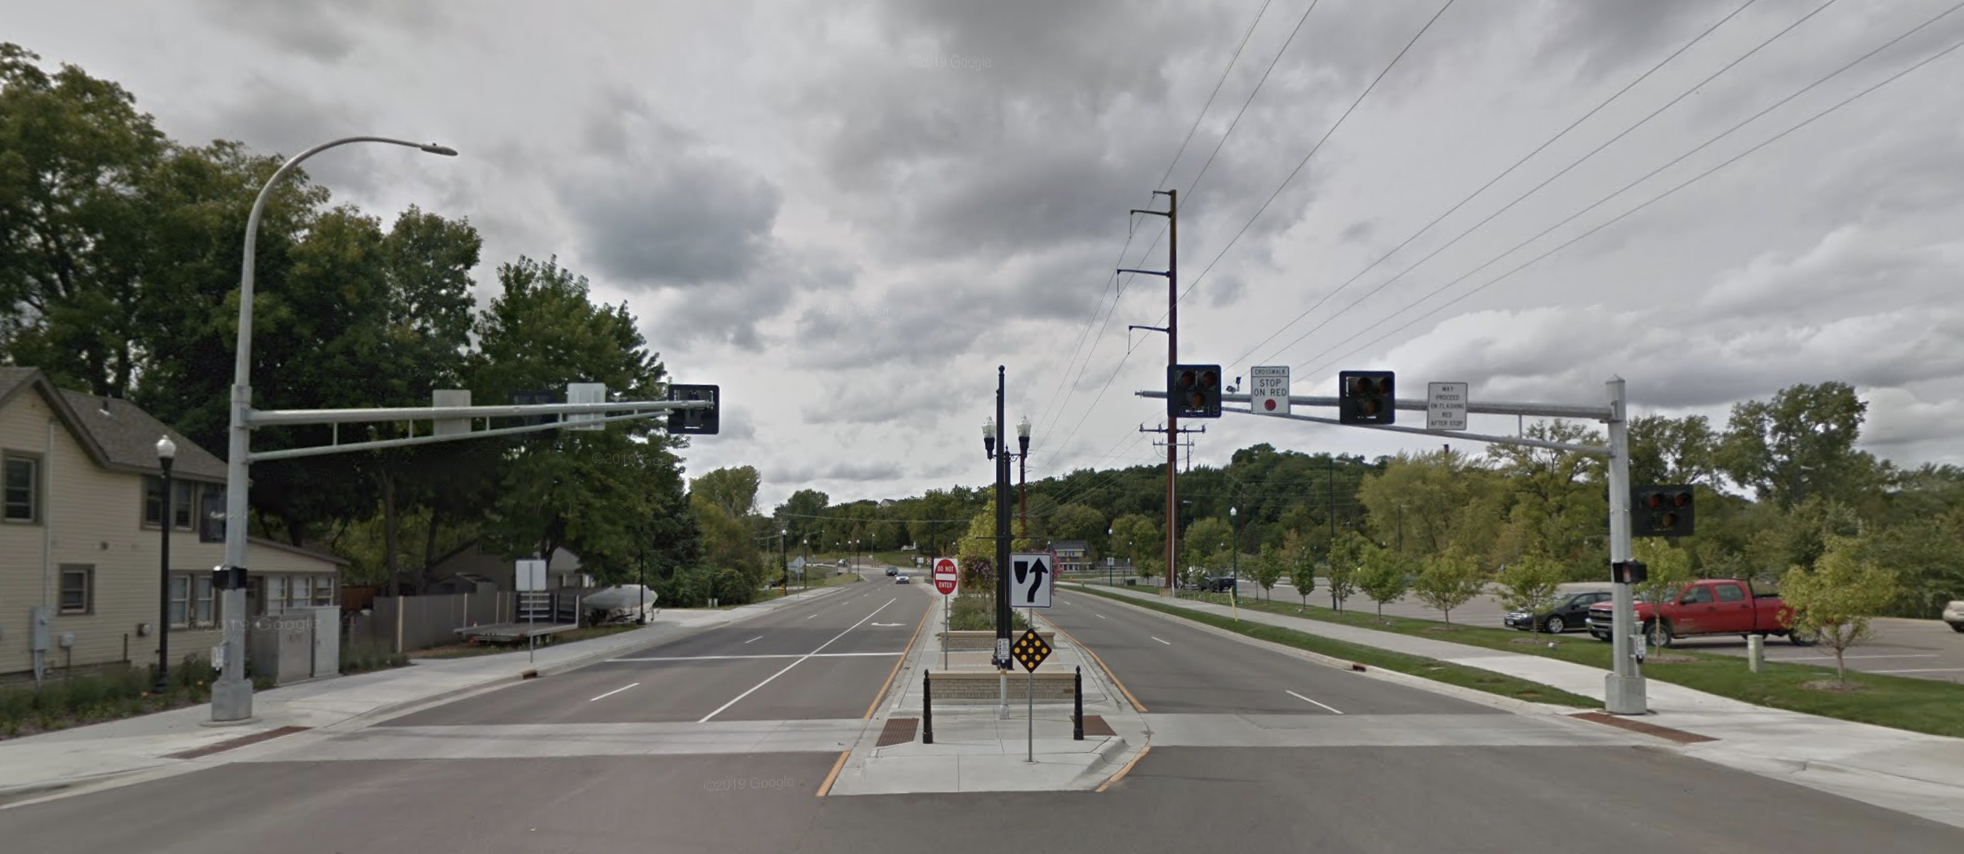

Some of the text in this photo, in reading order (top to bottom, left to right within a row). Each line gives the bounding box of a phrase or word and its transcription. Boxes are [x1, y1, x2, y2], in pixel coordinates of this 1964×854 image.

[1254, 368, 1286, 376] CROSSWALK
[1259, 379, 1282, 388] STOP
[1253, 388, 1287, 397] ON RED
[1439, 402, 1465, 410] FLASHING
[938, 581, 953, 589] ENTER
